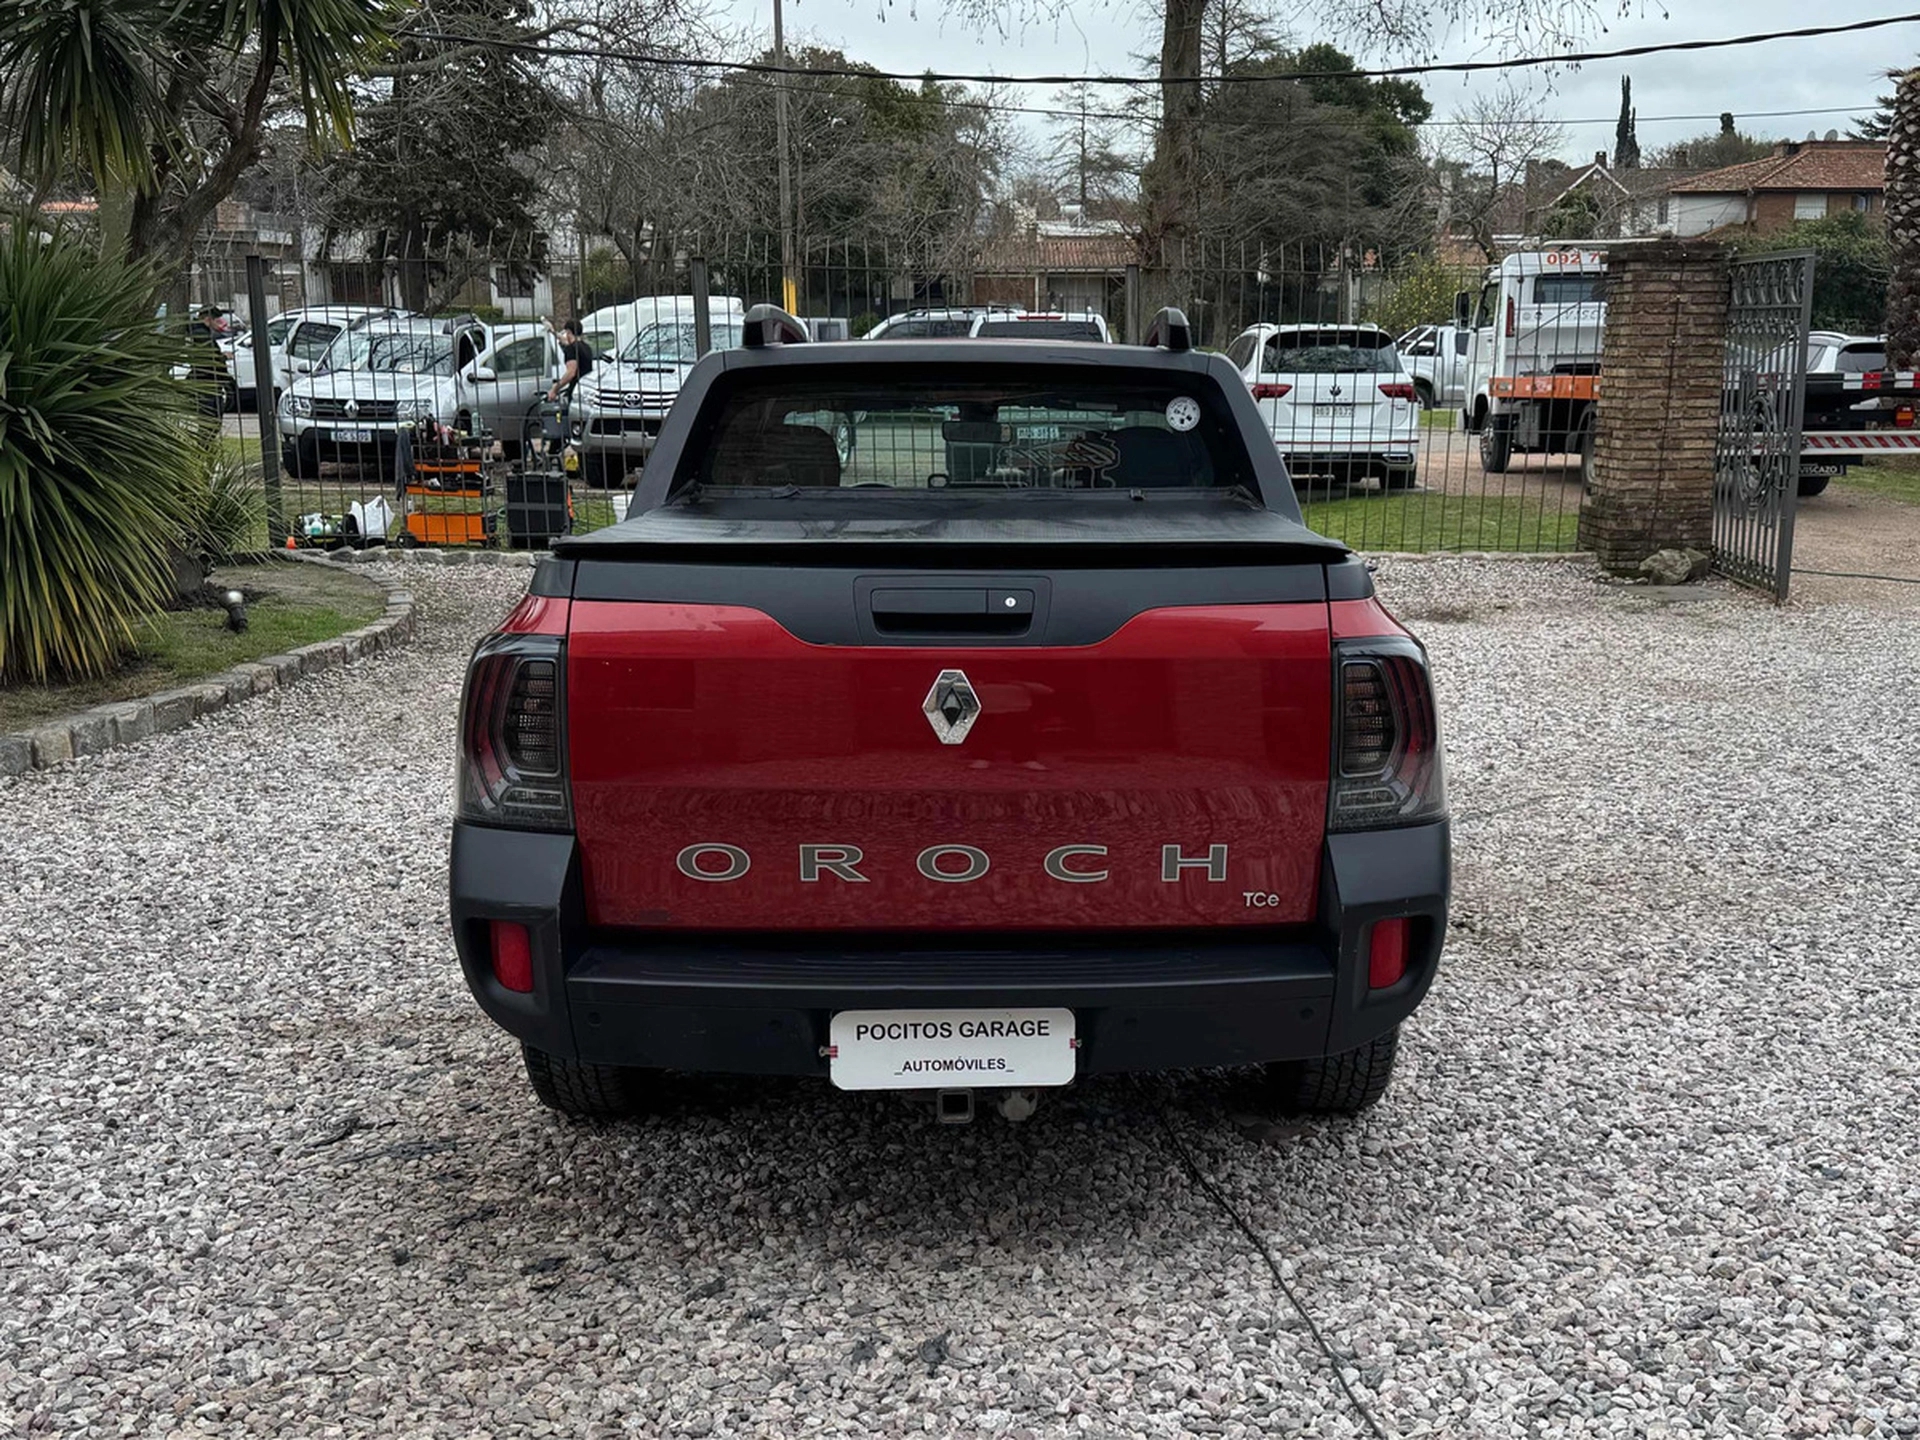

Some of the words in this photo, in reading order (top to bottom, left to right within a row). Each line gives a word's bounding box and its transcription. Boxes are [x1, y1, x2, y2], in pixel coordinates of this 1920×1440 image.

[1547, 253, 1580, 265] 092
[676, 842, 1228, 882] OROCH
[1243, 891, 1280, 908] TCe
[856, 1022, 952, 1041] POCITOS
[958, 1020, 1050, 1038] GARAGE
